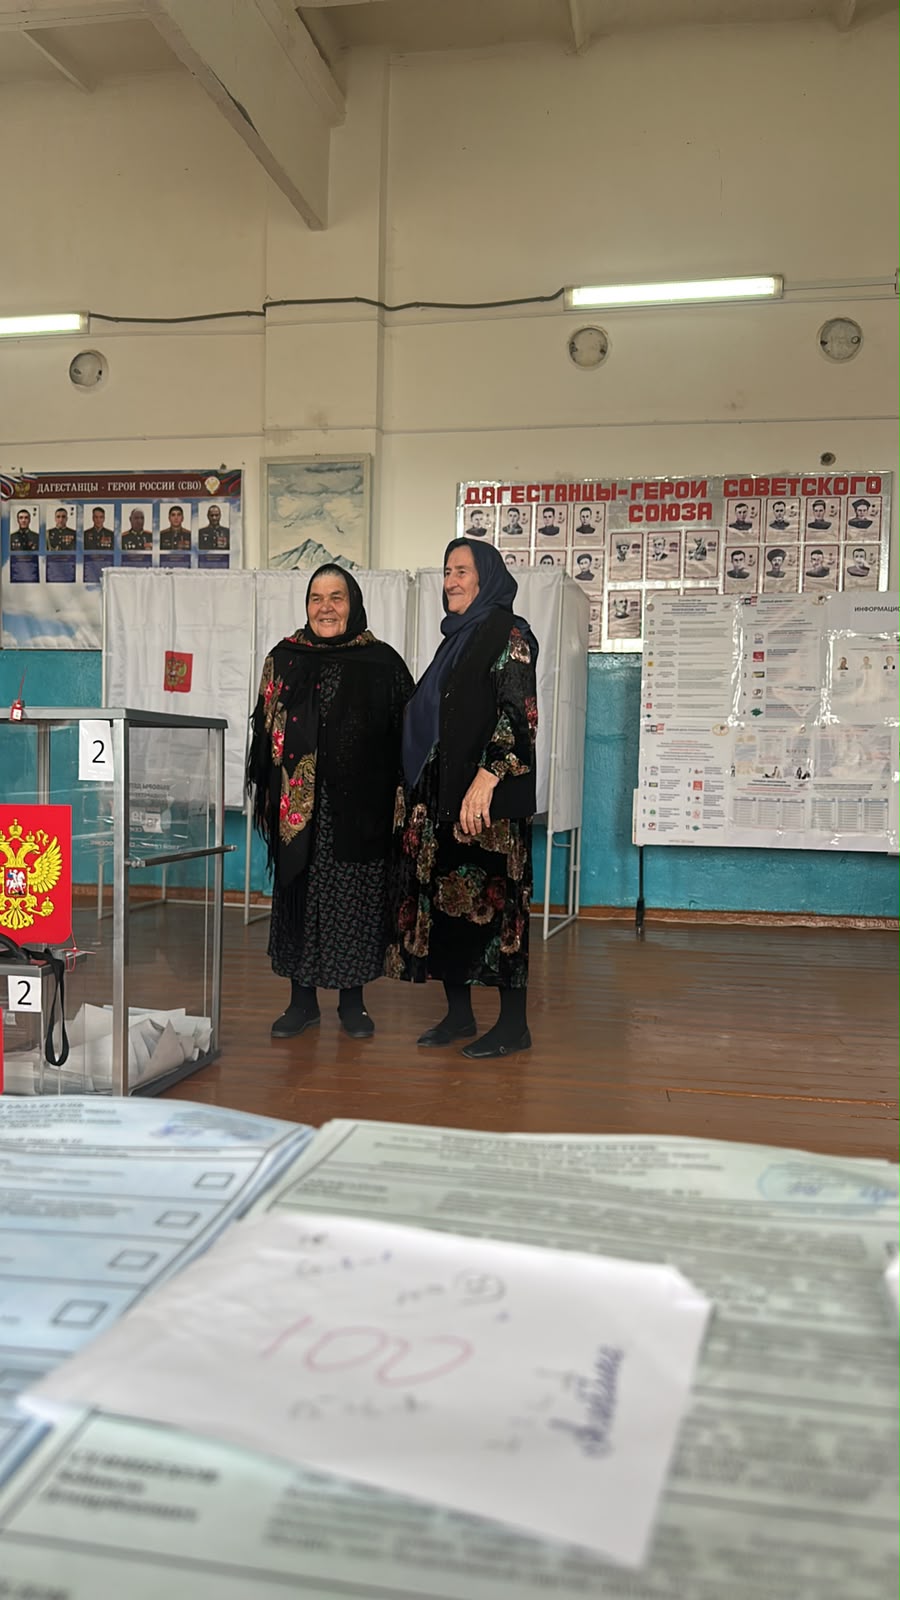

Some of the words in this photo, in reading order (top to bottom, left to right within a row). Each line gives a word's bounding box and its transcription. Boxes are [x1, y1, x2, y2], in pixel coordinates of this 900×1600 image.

[37, 483, 99, 493] ДАГЕСТАНЦЫ
[107, 482, 136, 491] ГЕРОИ
[139, 481, 175, 491] РОССИИ
[177, 480, 202, 491] (СВО)
[723, 476, 882, 498] СОВЕТСКОГО
[627, 502, 713, 523] СОЮЗА
[92, 740, 106, 764] 2
[17, 980, 32, 1006] 2
